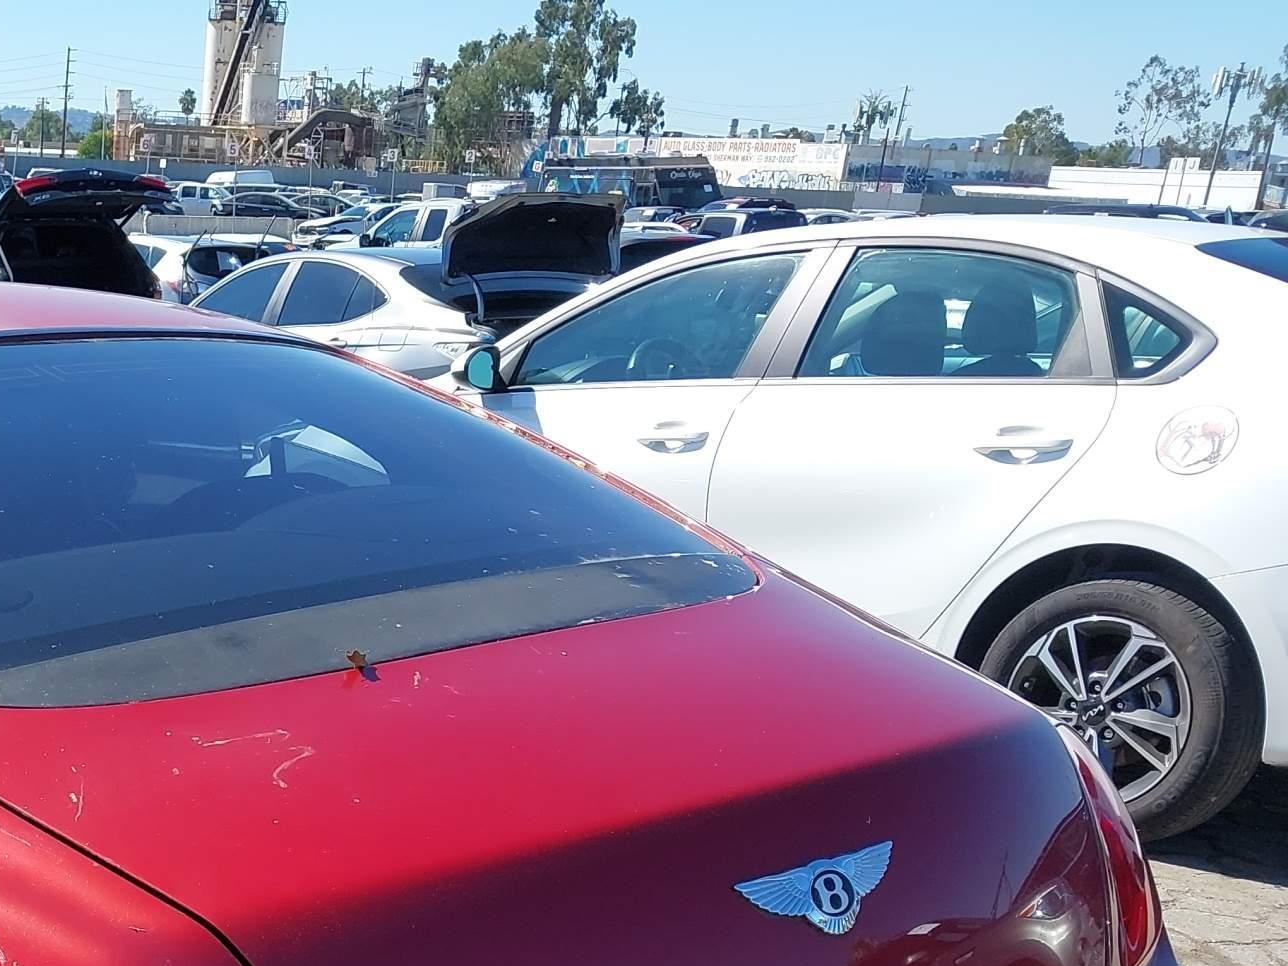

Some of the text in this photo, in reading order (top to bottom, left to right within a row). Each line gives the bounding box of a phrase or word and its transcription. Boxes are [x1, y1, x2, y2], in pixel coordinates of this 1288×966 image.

[142, 138, 150, 150] 6
[229, 143, 237, 155] 5
[664, 140, 681, 151] AUTO
[389, 150, 395, 161] 3
[467, 151, 473, 161] 2
[814, 873, 851, 914] B
